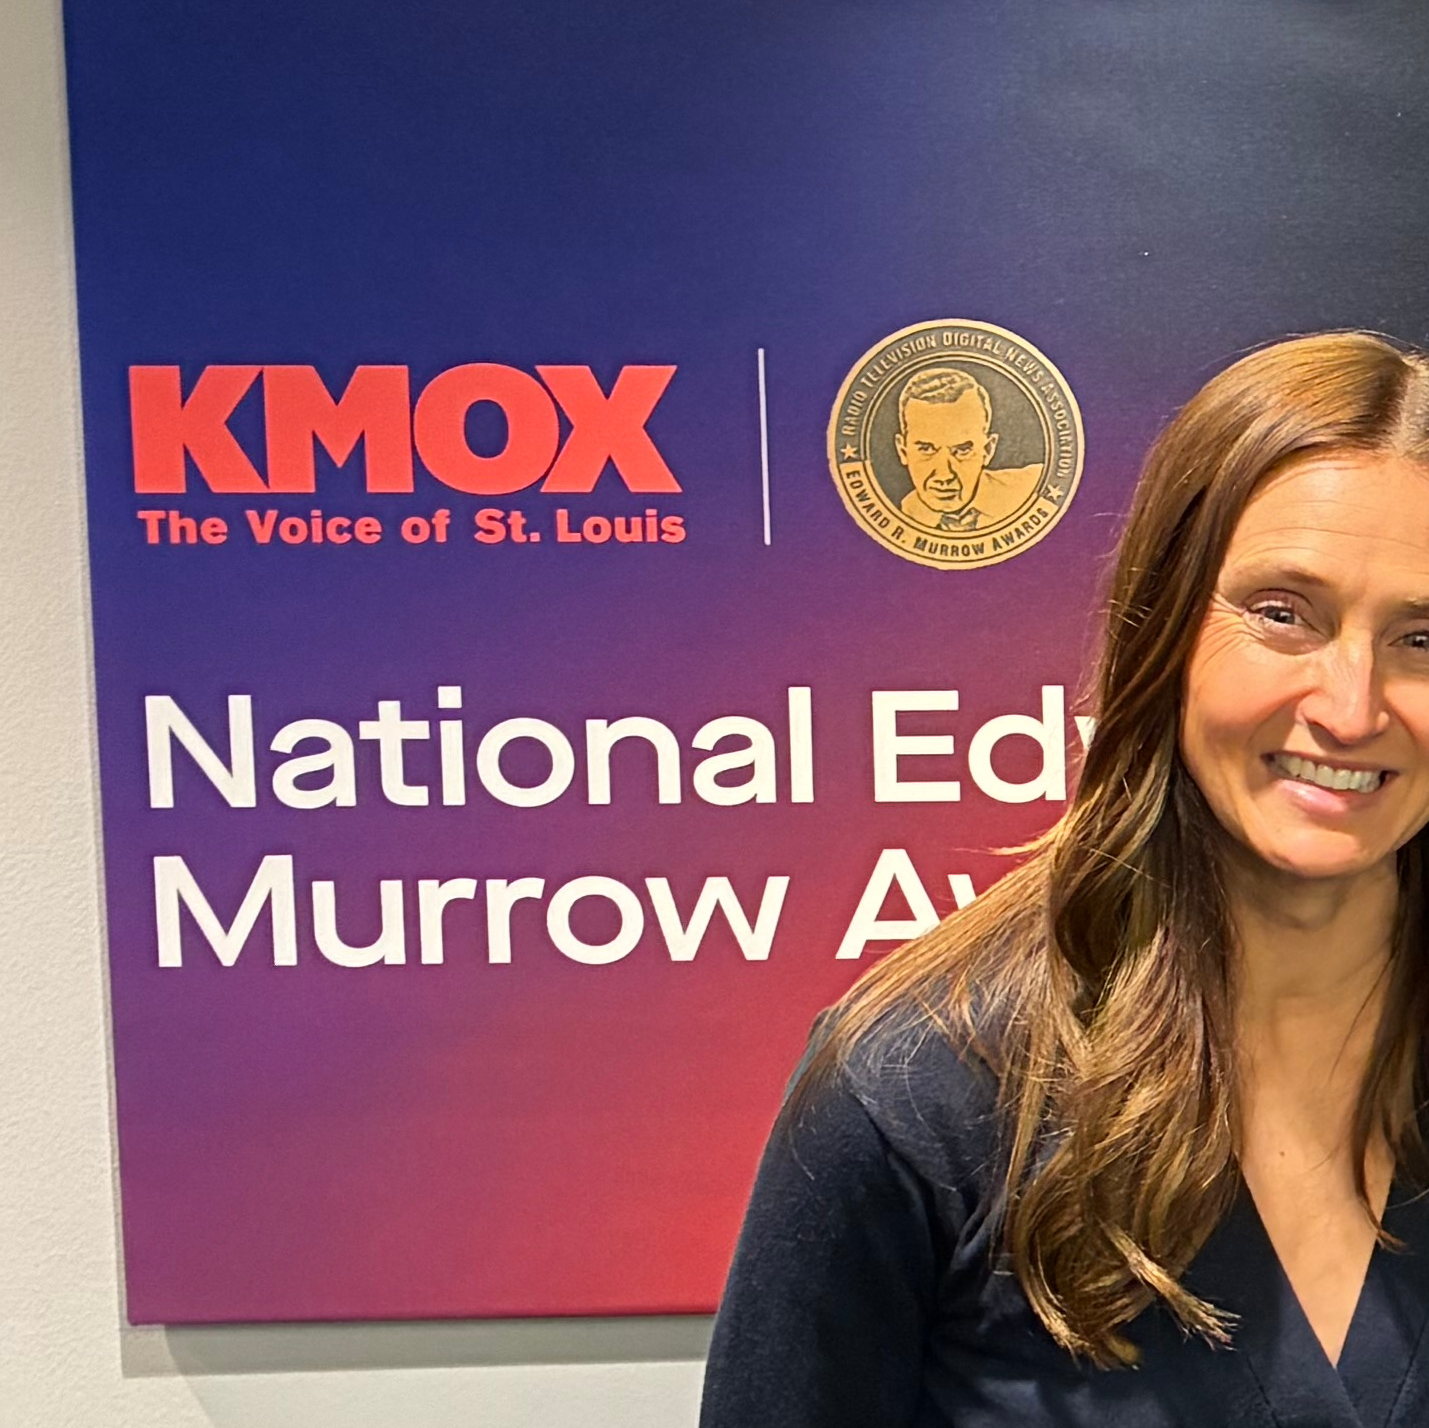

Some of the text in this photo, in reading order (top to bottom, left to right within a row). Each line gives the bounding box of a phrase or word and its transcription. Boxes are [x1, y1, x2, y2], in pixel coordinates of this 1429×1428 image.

[129, 362, 683, 495] KMOX
[841, 331, 1076, 478] RADIO TELEVISION DIGITAL NEWS ASSOCIATION
[137, 507, 686, 545] The Voice of St. Louis
[846, 470, 1050, 558] EDWARD R. MURROW AWARDS
[144, 685, 814, 809] National
[153, 854, 790, 967] Murrow
